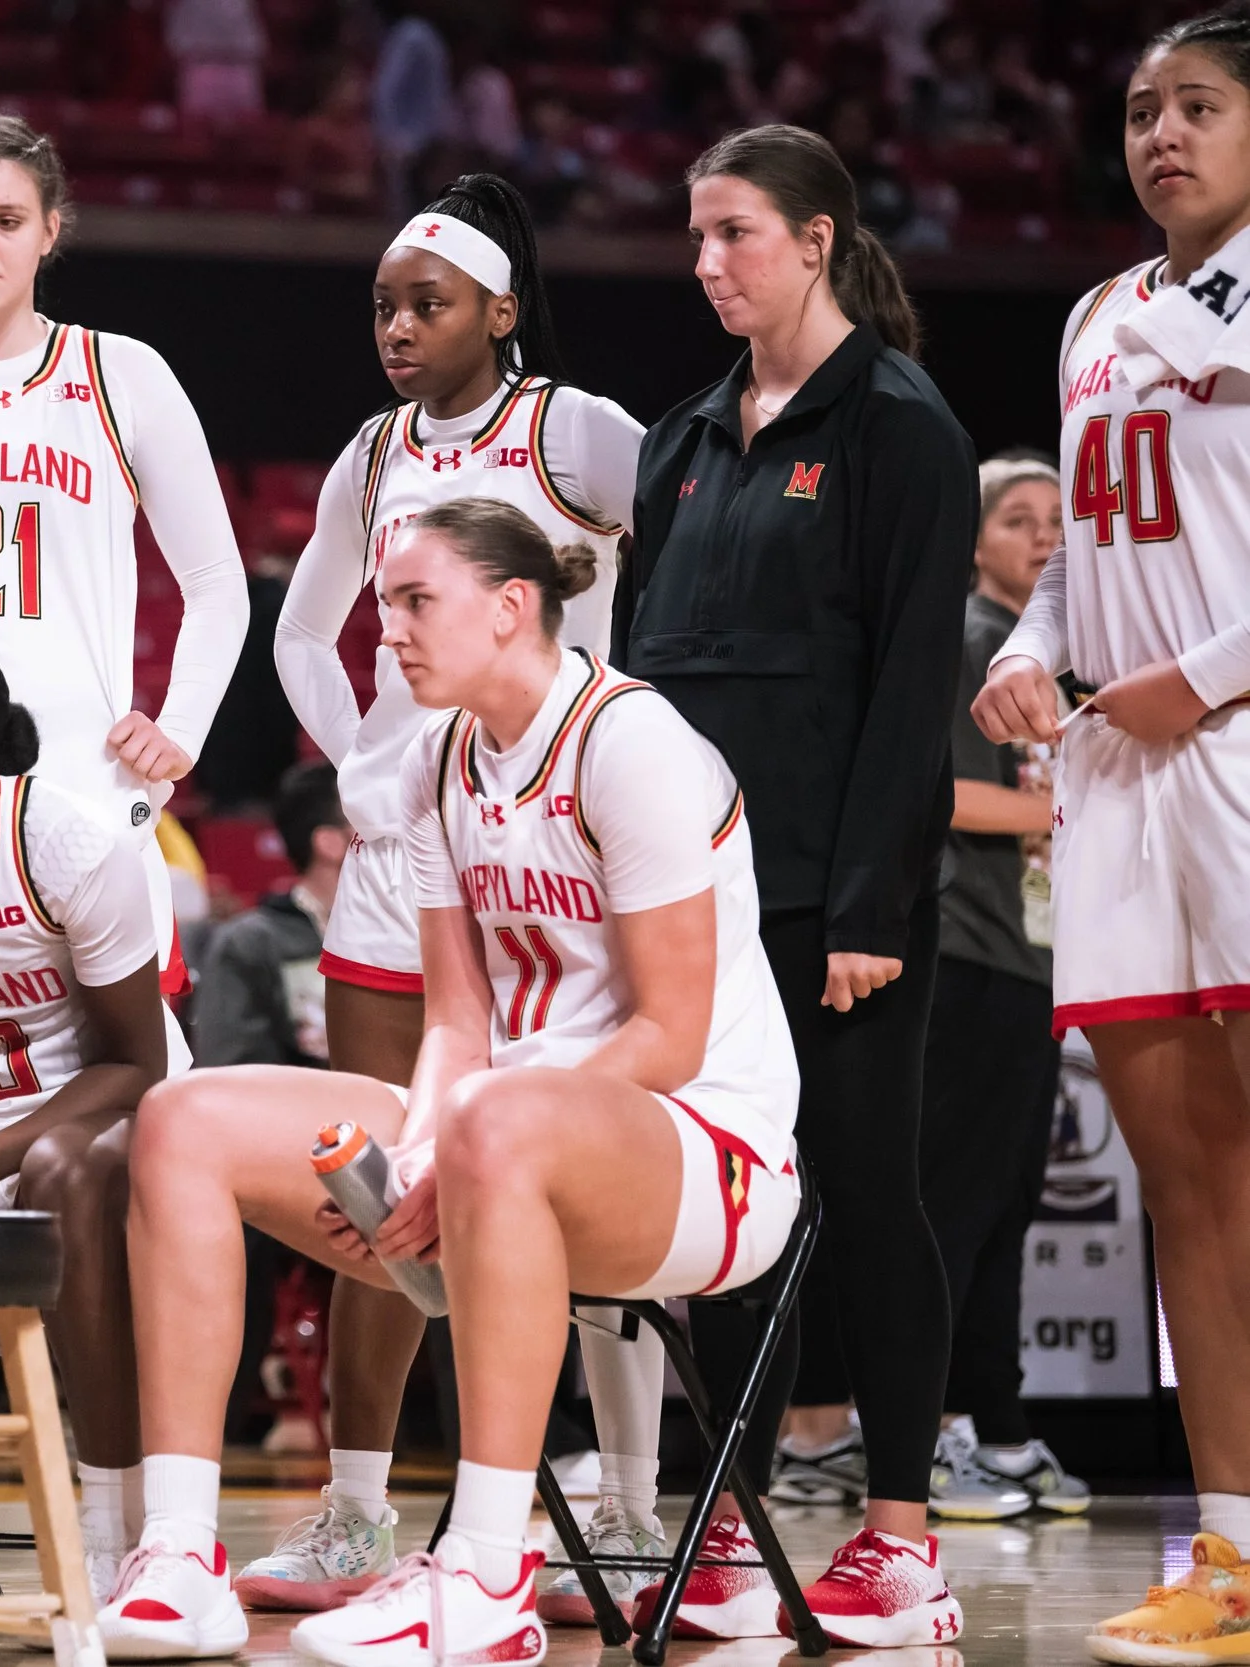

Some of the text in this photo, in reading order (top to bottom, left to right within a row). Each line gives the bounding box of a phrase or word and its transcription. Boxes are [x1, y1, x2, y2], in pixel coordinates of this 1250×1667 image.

[785, 462, 825, 495] M
[1072, 409, 1180, 547] 40
[494, 925, 563, 1040] 11
